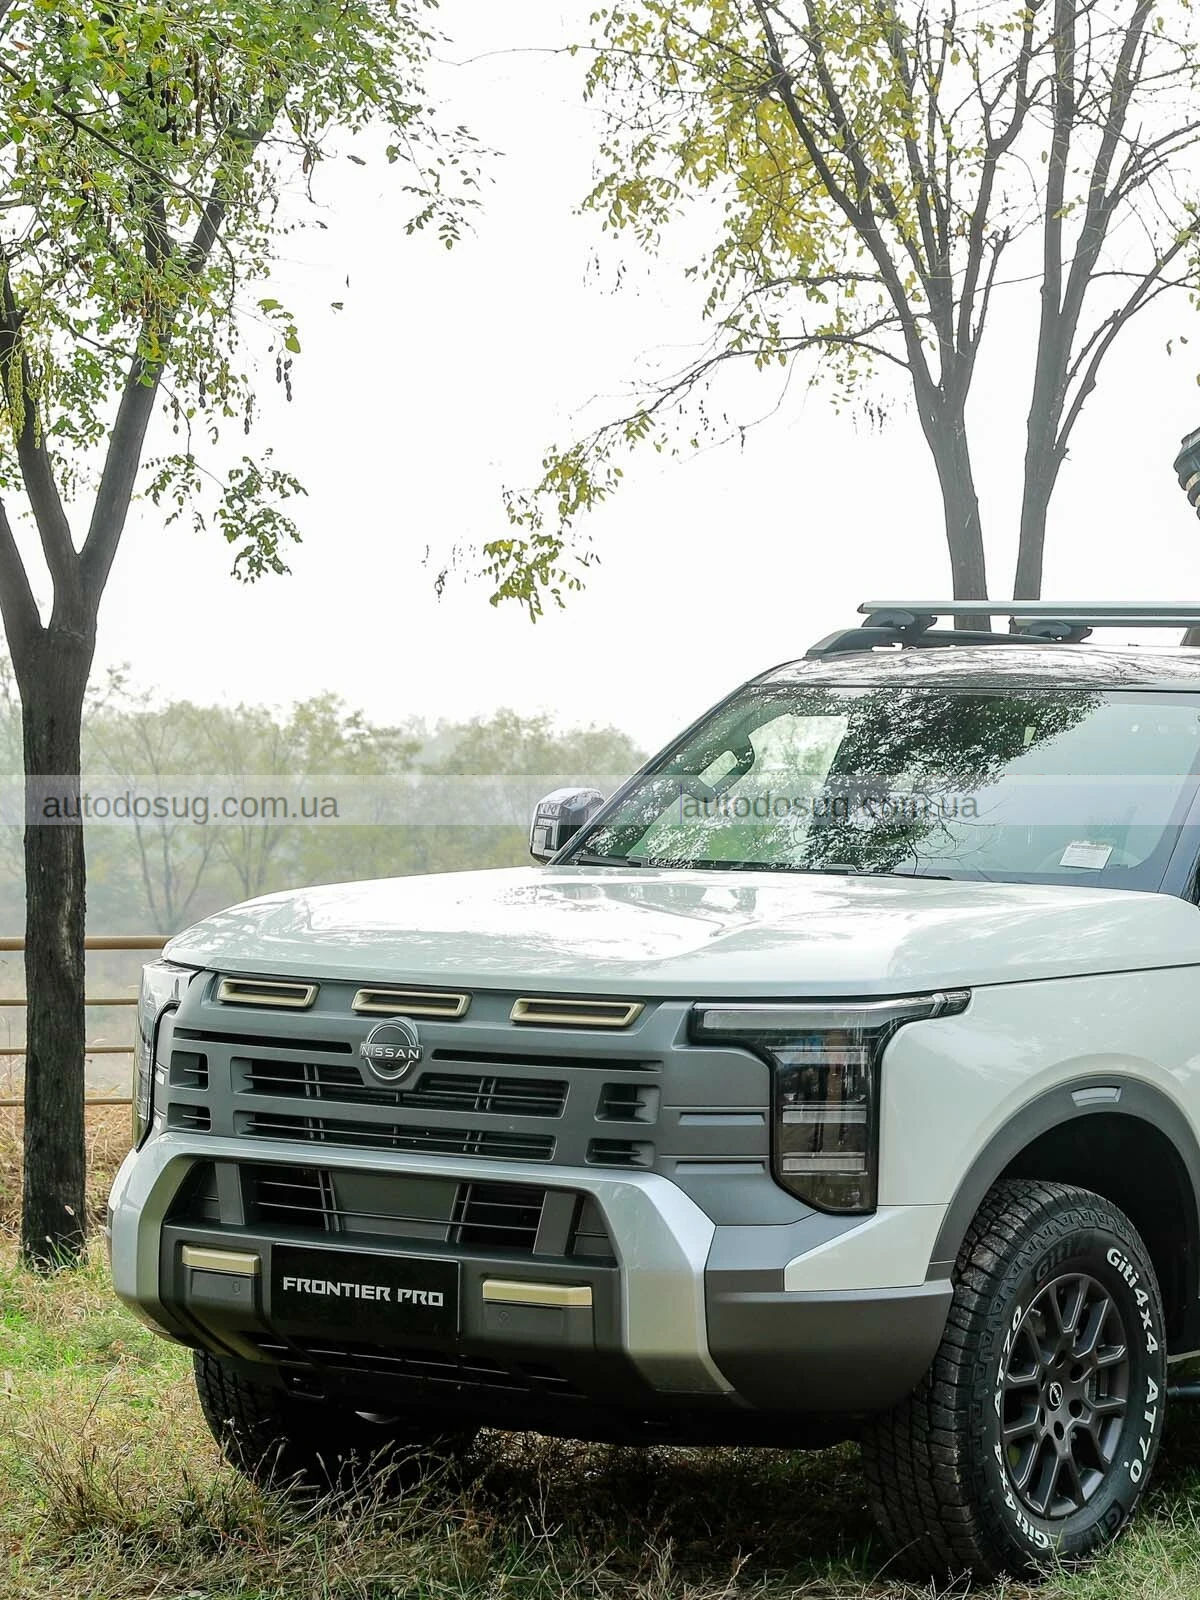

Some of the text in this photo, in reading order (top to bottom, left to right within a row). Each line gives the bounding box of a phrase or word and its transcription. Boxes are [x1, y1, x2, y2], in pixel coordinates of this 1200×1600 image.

[361, 1045, 419, 1059] NISSAN
[283, 1276, 443, 1307] FRONTIER PRO
[1130, 1375, 1159, 1483] AT70
